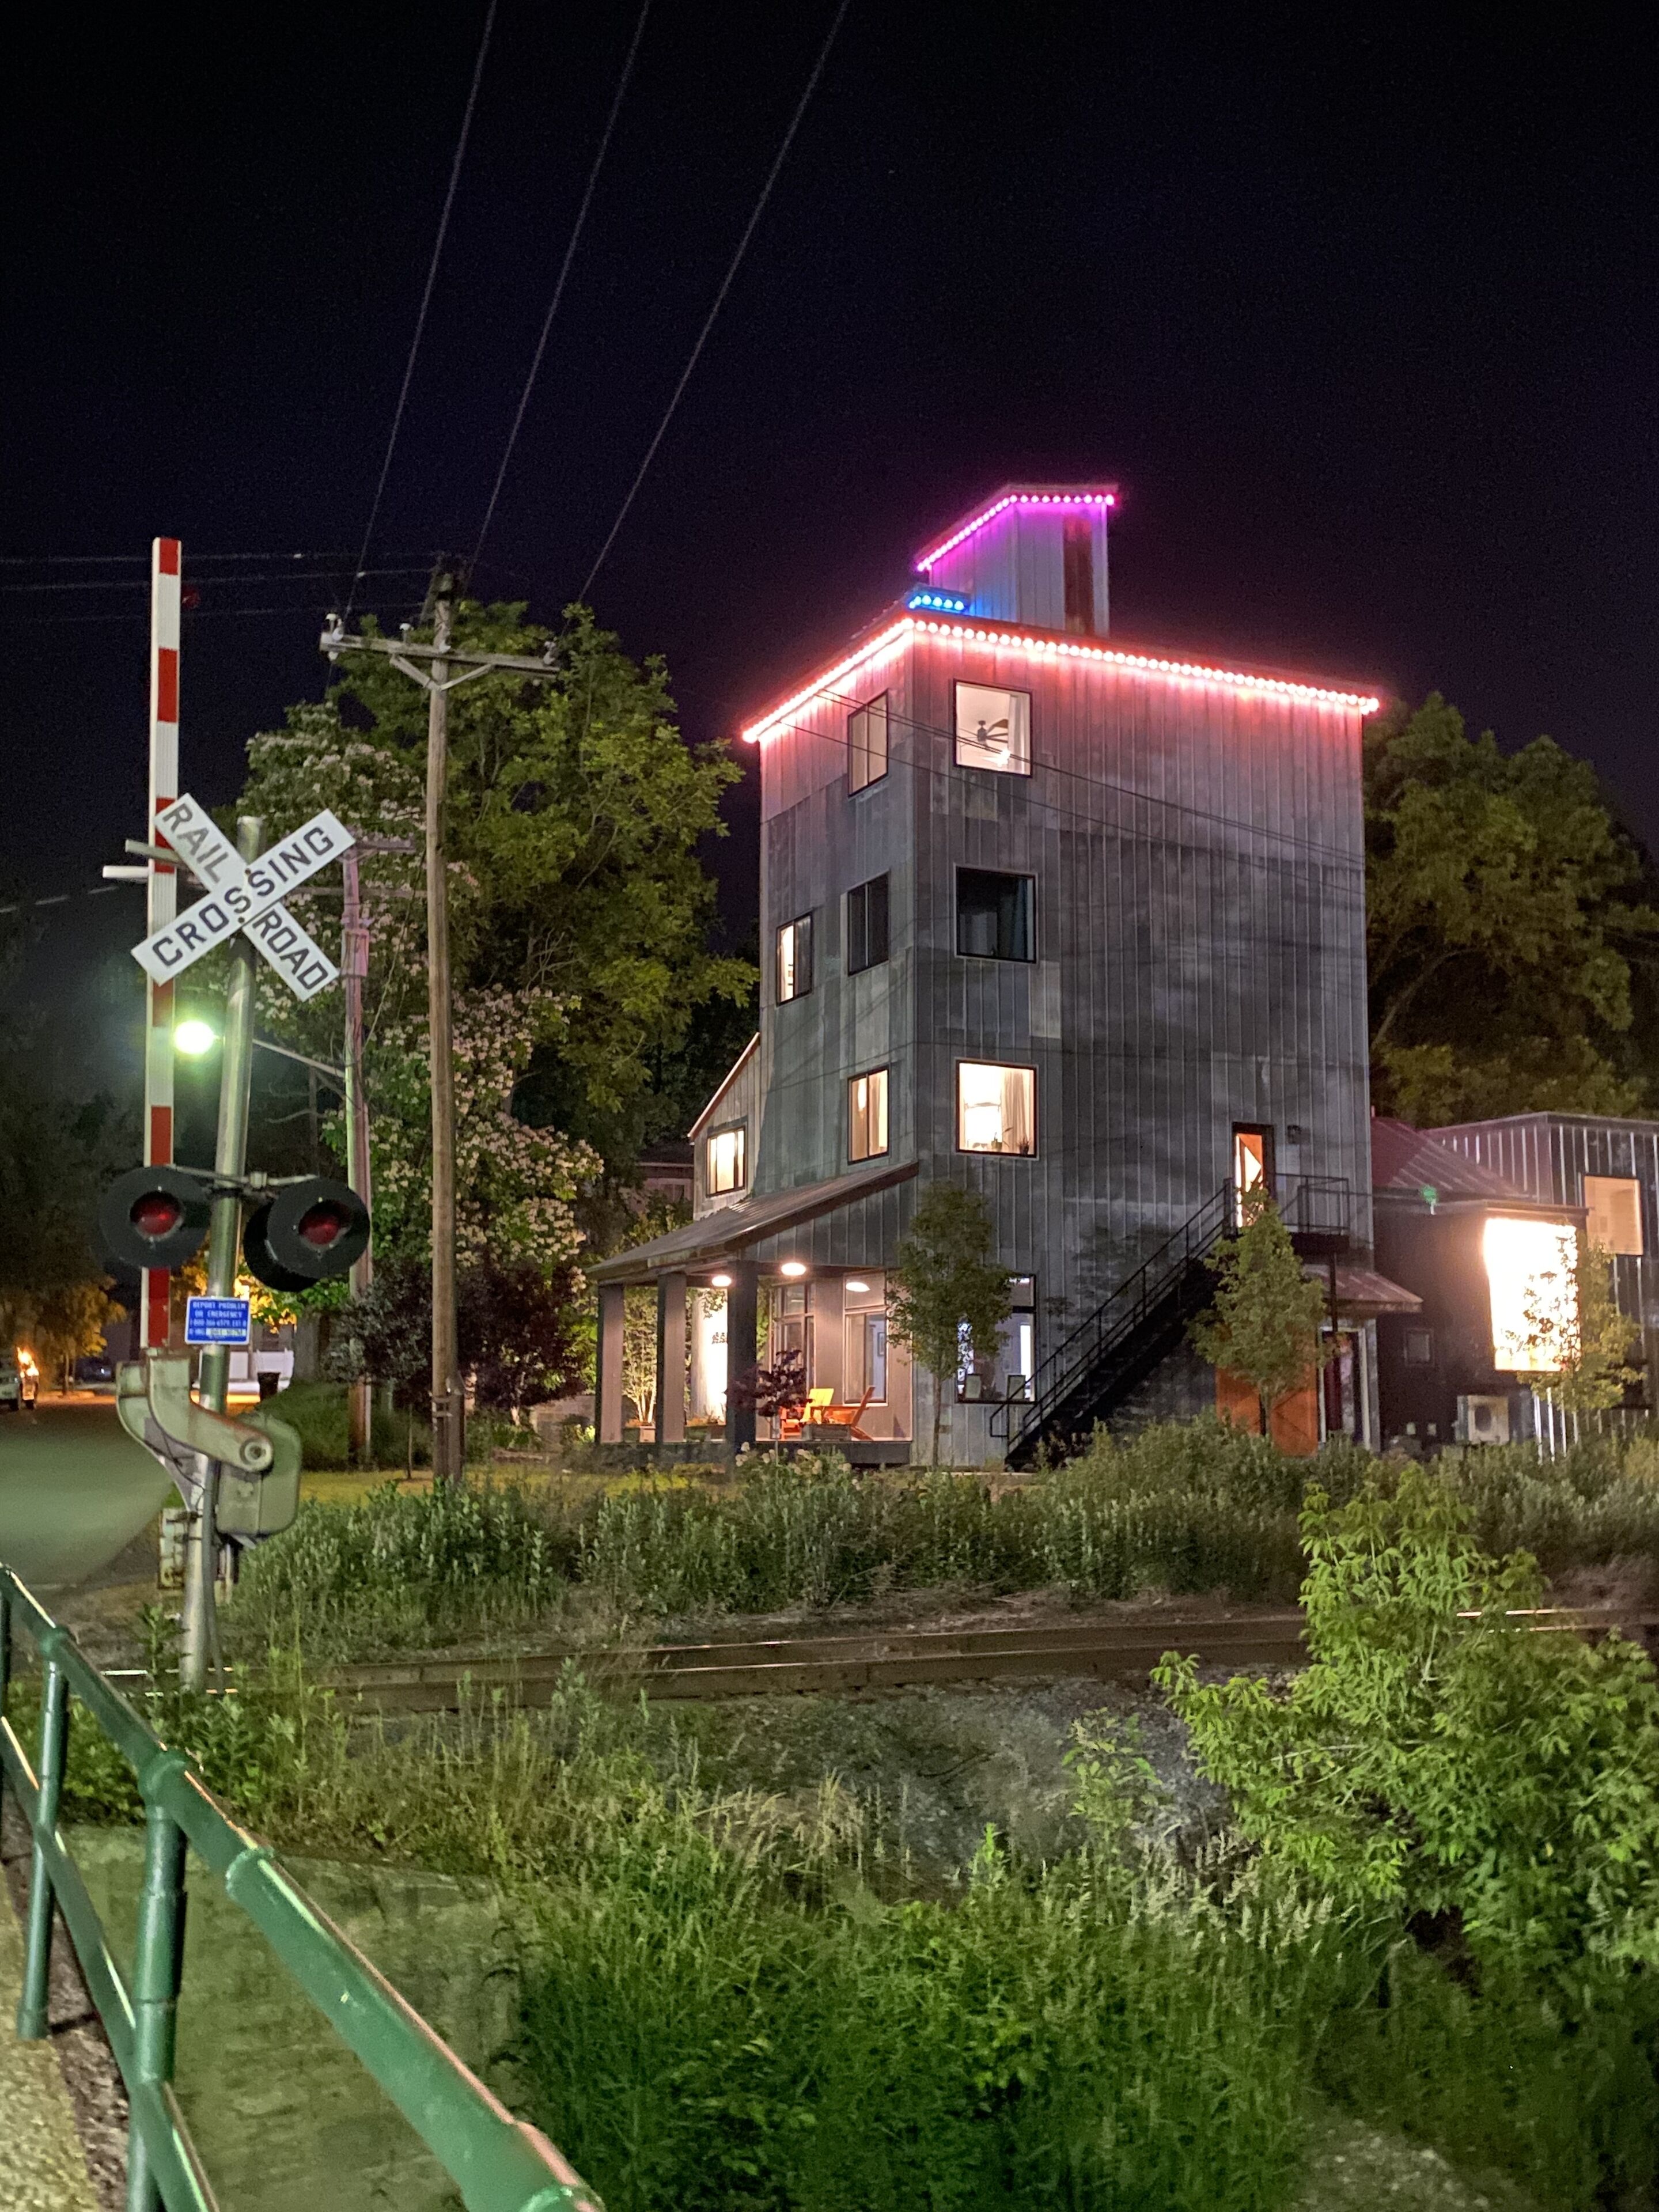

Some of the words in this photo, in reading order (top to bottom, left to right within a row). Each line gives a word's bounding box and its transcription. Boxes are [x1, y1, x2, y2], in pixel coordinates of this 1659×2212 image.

[151, 827, 334, 968] CROSSING
[162, 802, 229, 884] RAIL
[252, 908, 329, 990] ROAD
